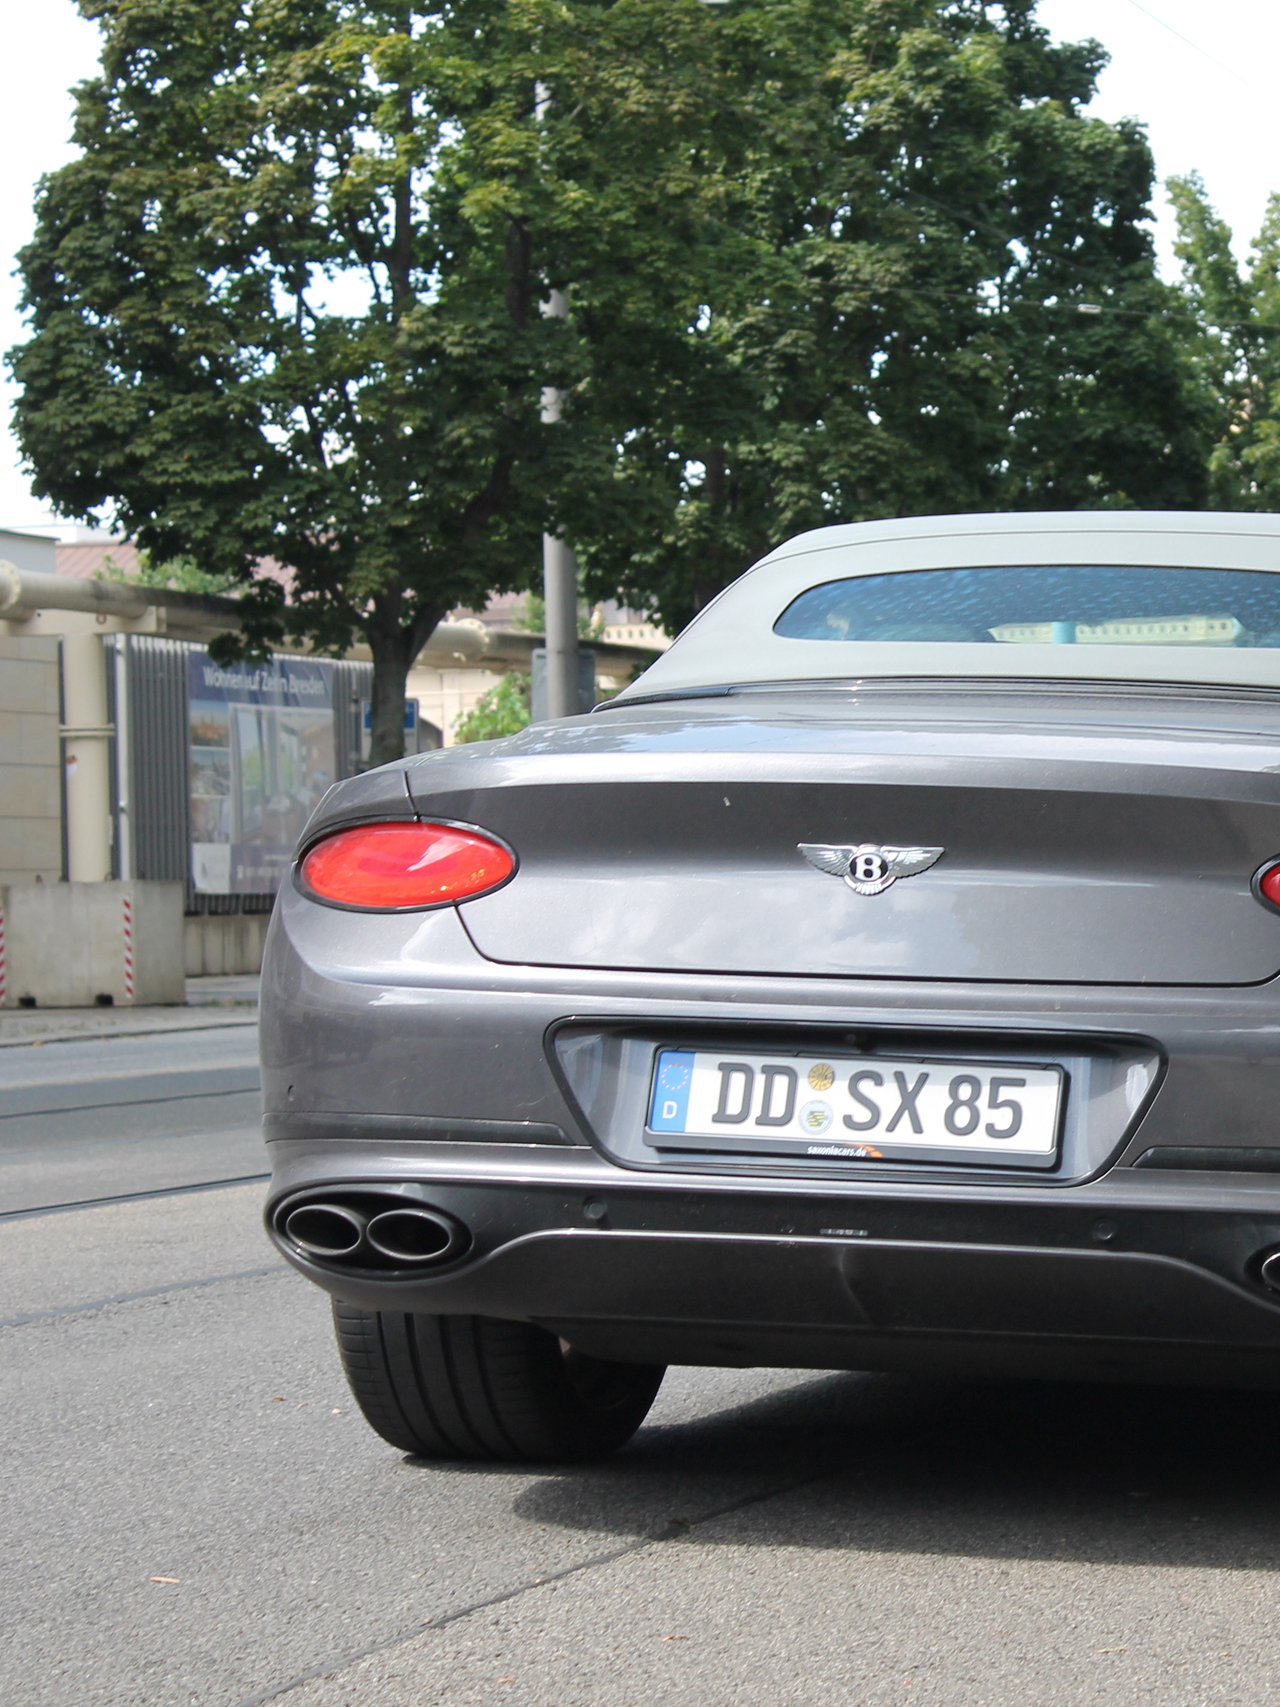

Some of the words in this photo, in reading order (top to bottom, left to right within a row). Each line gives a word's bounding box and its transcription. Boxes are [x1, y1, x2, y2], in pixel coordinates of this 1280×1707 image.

[854, 853, 882, 881] B
[662, 1101, 678, 1119] D
[712, 1062, 798, 1126] DD
[842, 1069, 929, 1134] SX
[943, 1074, 1027, 1140] 85
[807, 1144, 867, 1157] saxoniacars.de
